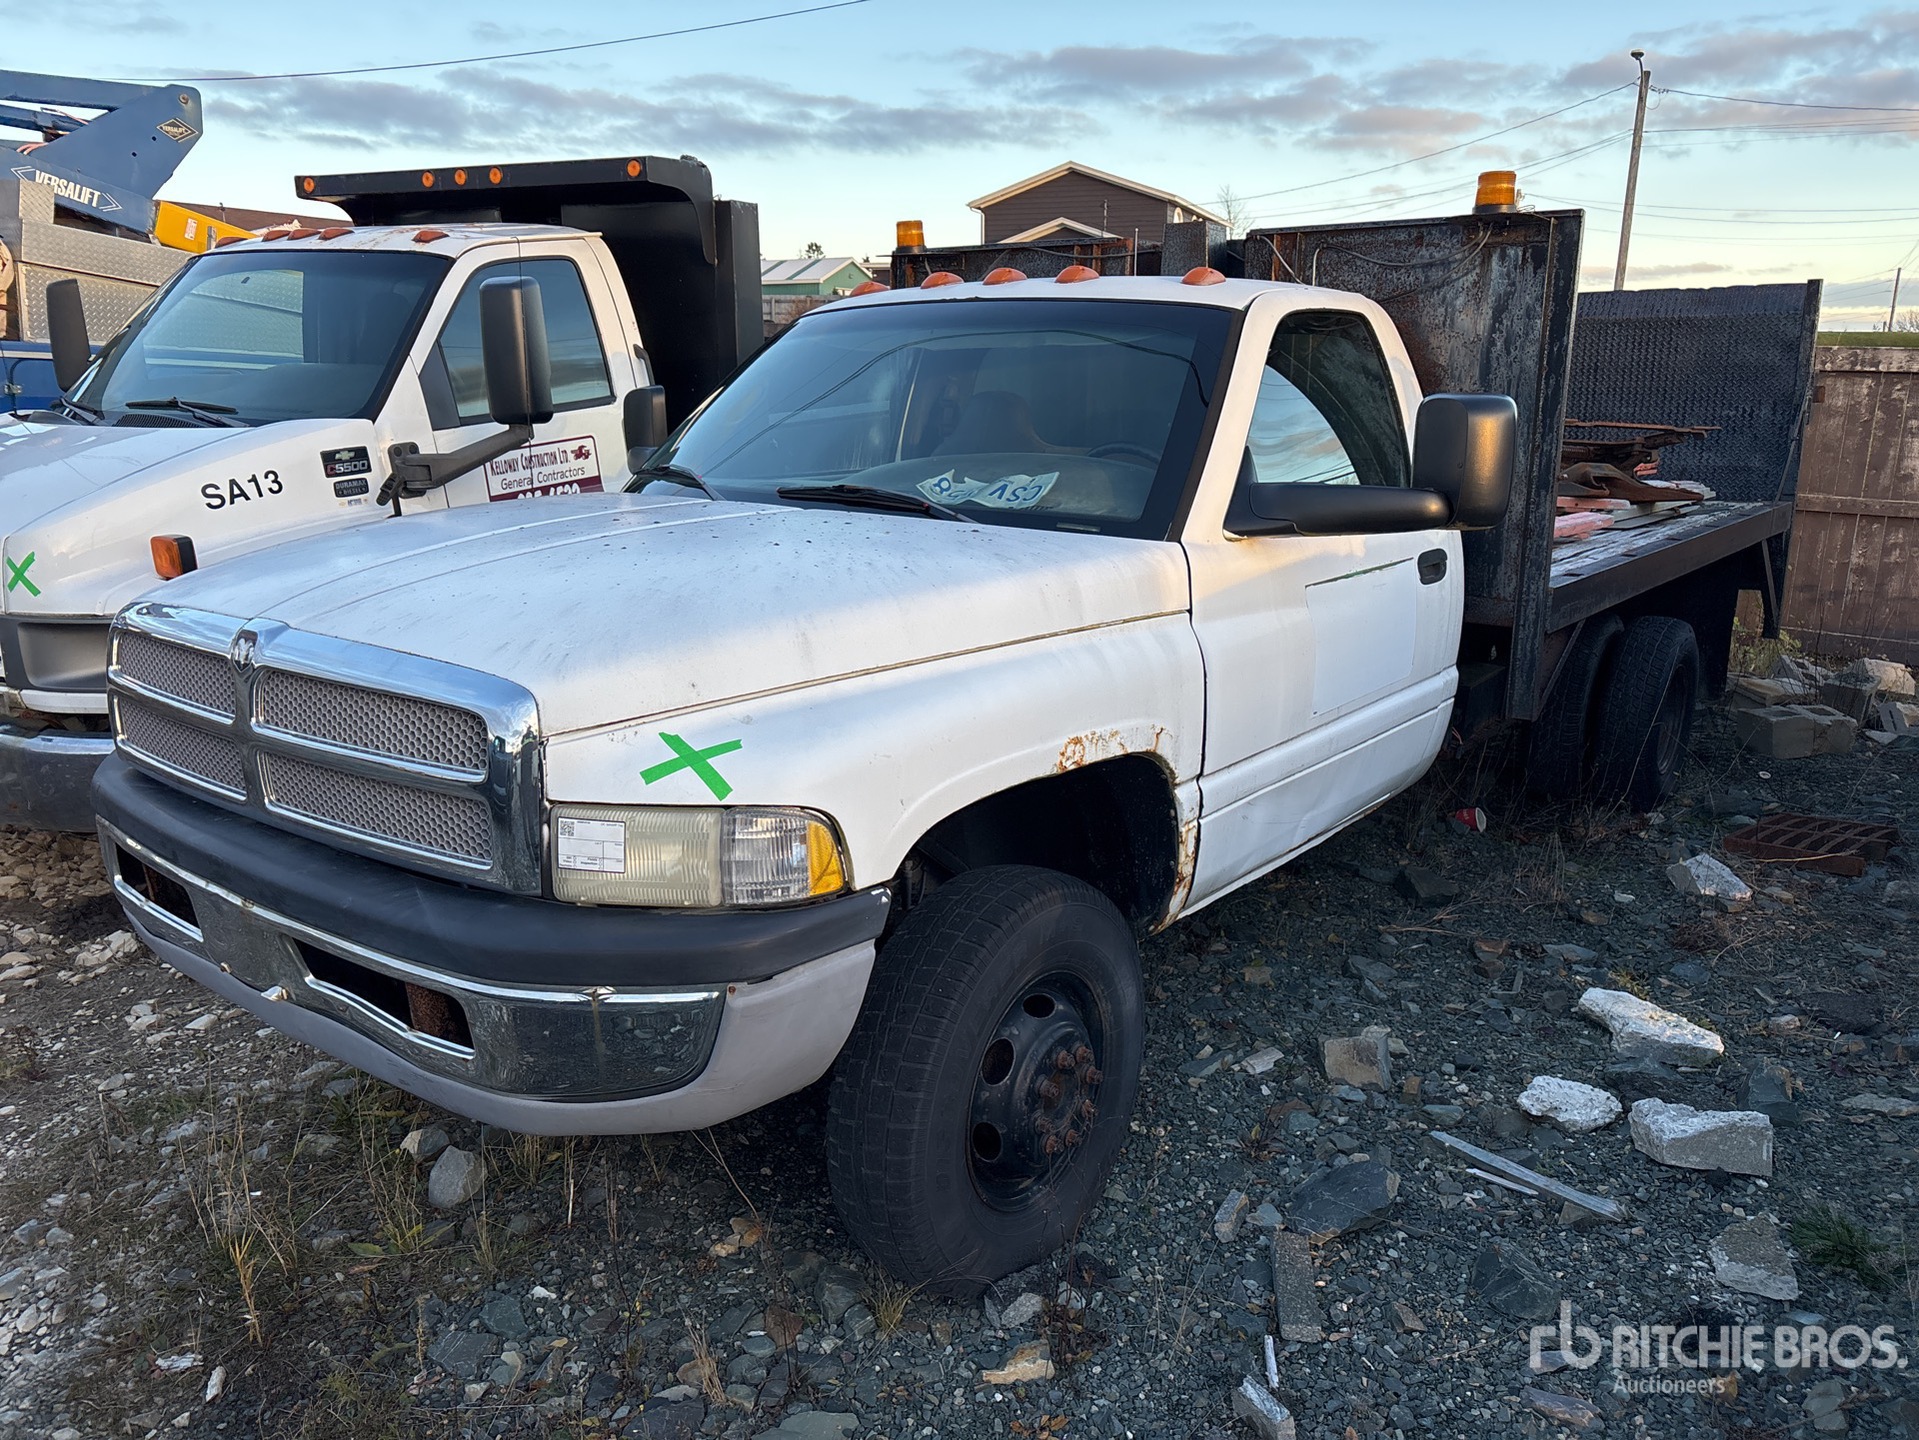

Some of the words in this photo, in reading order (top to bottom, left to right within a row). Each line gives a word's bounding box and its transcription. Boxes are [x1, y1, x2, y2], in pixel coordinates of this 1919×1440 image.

[35, 169, 101, 208] VERSALIFT
[327, 460, 368, 475] C5500
[501, 476, 533, 490] Genera
[537, 466, 586, 484] Contractors
[201, 470, 284, 510] SA13
[335, 479, 367, 490] DURAMAX
